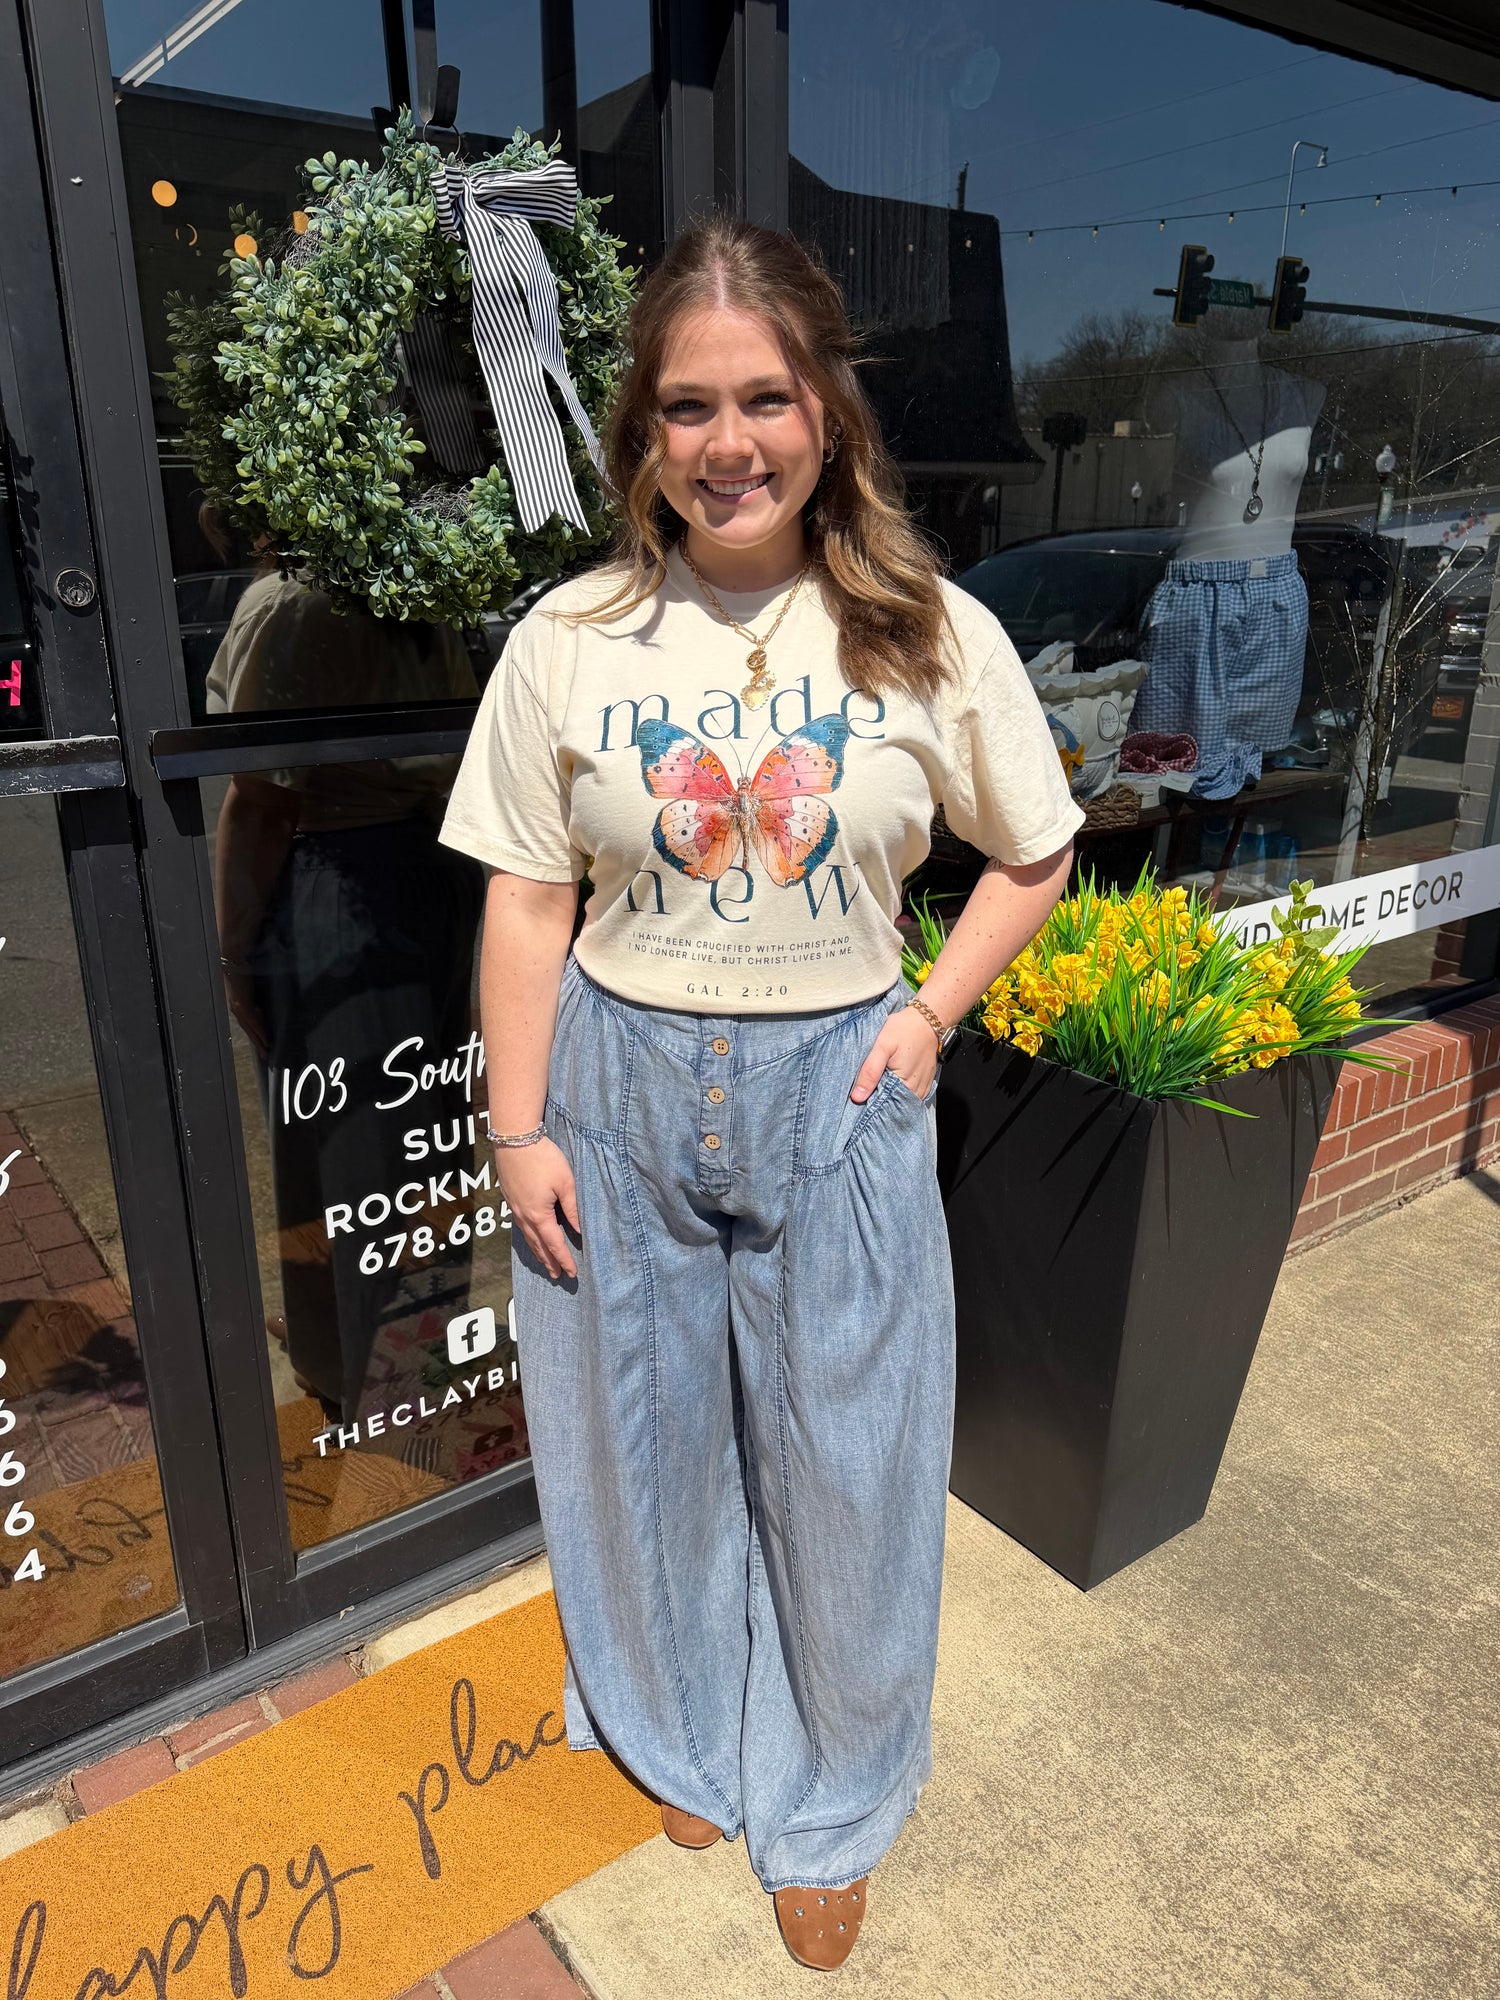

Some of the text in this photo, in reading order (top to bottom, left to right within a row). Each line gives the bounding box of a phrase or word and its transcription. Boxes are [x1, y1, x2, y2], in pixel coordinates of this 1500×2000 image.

[593, 674, 886, 753] made
[624, 861, 861, 923] new
[1297, 895, 1368, 933] OME
[1377, 871, 1464, 921] DECOR
[634, 943, 647, 952] NO
[650, 946, 688, 959] LONGER
[691, 952, 717, 964] LIVE,
[721, 956, 742, 965] BUT
[747, 956, 788, 965] CHRIST
[792, 952, 822, 962] LIVES
[825, 950, 836, 958] IN
[638, 932, 663, 943] HAVE
[665, 937, 692, 947] BEEN
[696, 941, 751, 953] CRUCIFIED
[756, 945, 785, 953] WITH
[789, 940, 827, 951] CHRIST
[831, 936, 850, 946] AND
[686, 982, 788, 997] GAL 2:20
[282, 1056, 348, 1125] 103
[324, 1161, 501, 1239] ROCKM
[4, 1500, 35, 1537] 6
[13, 1548, 46, 1582] 4
